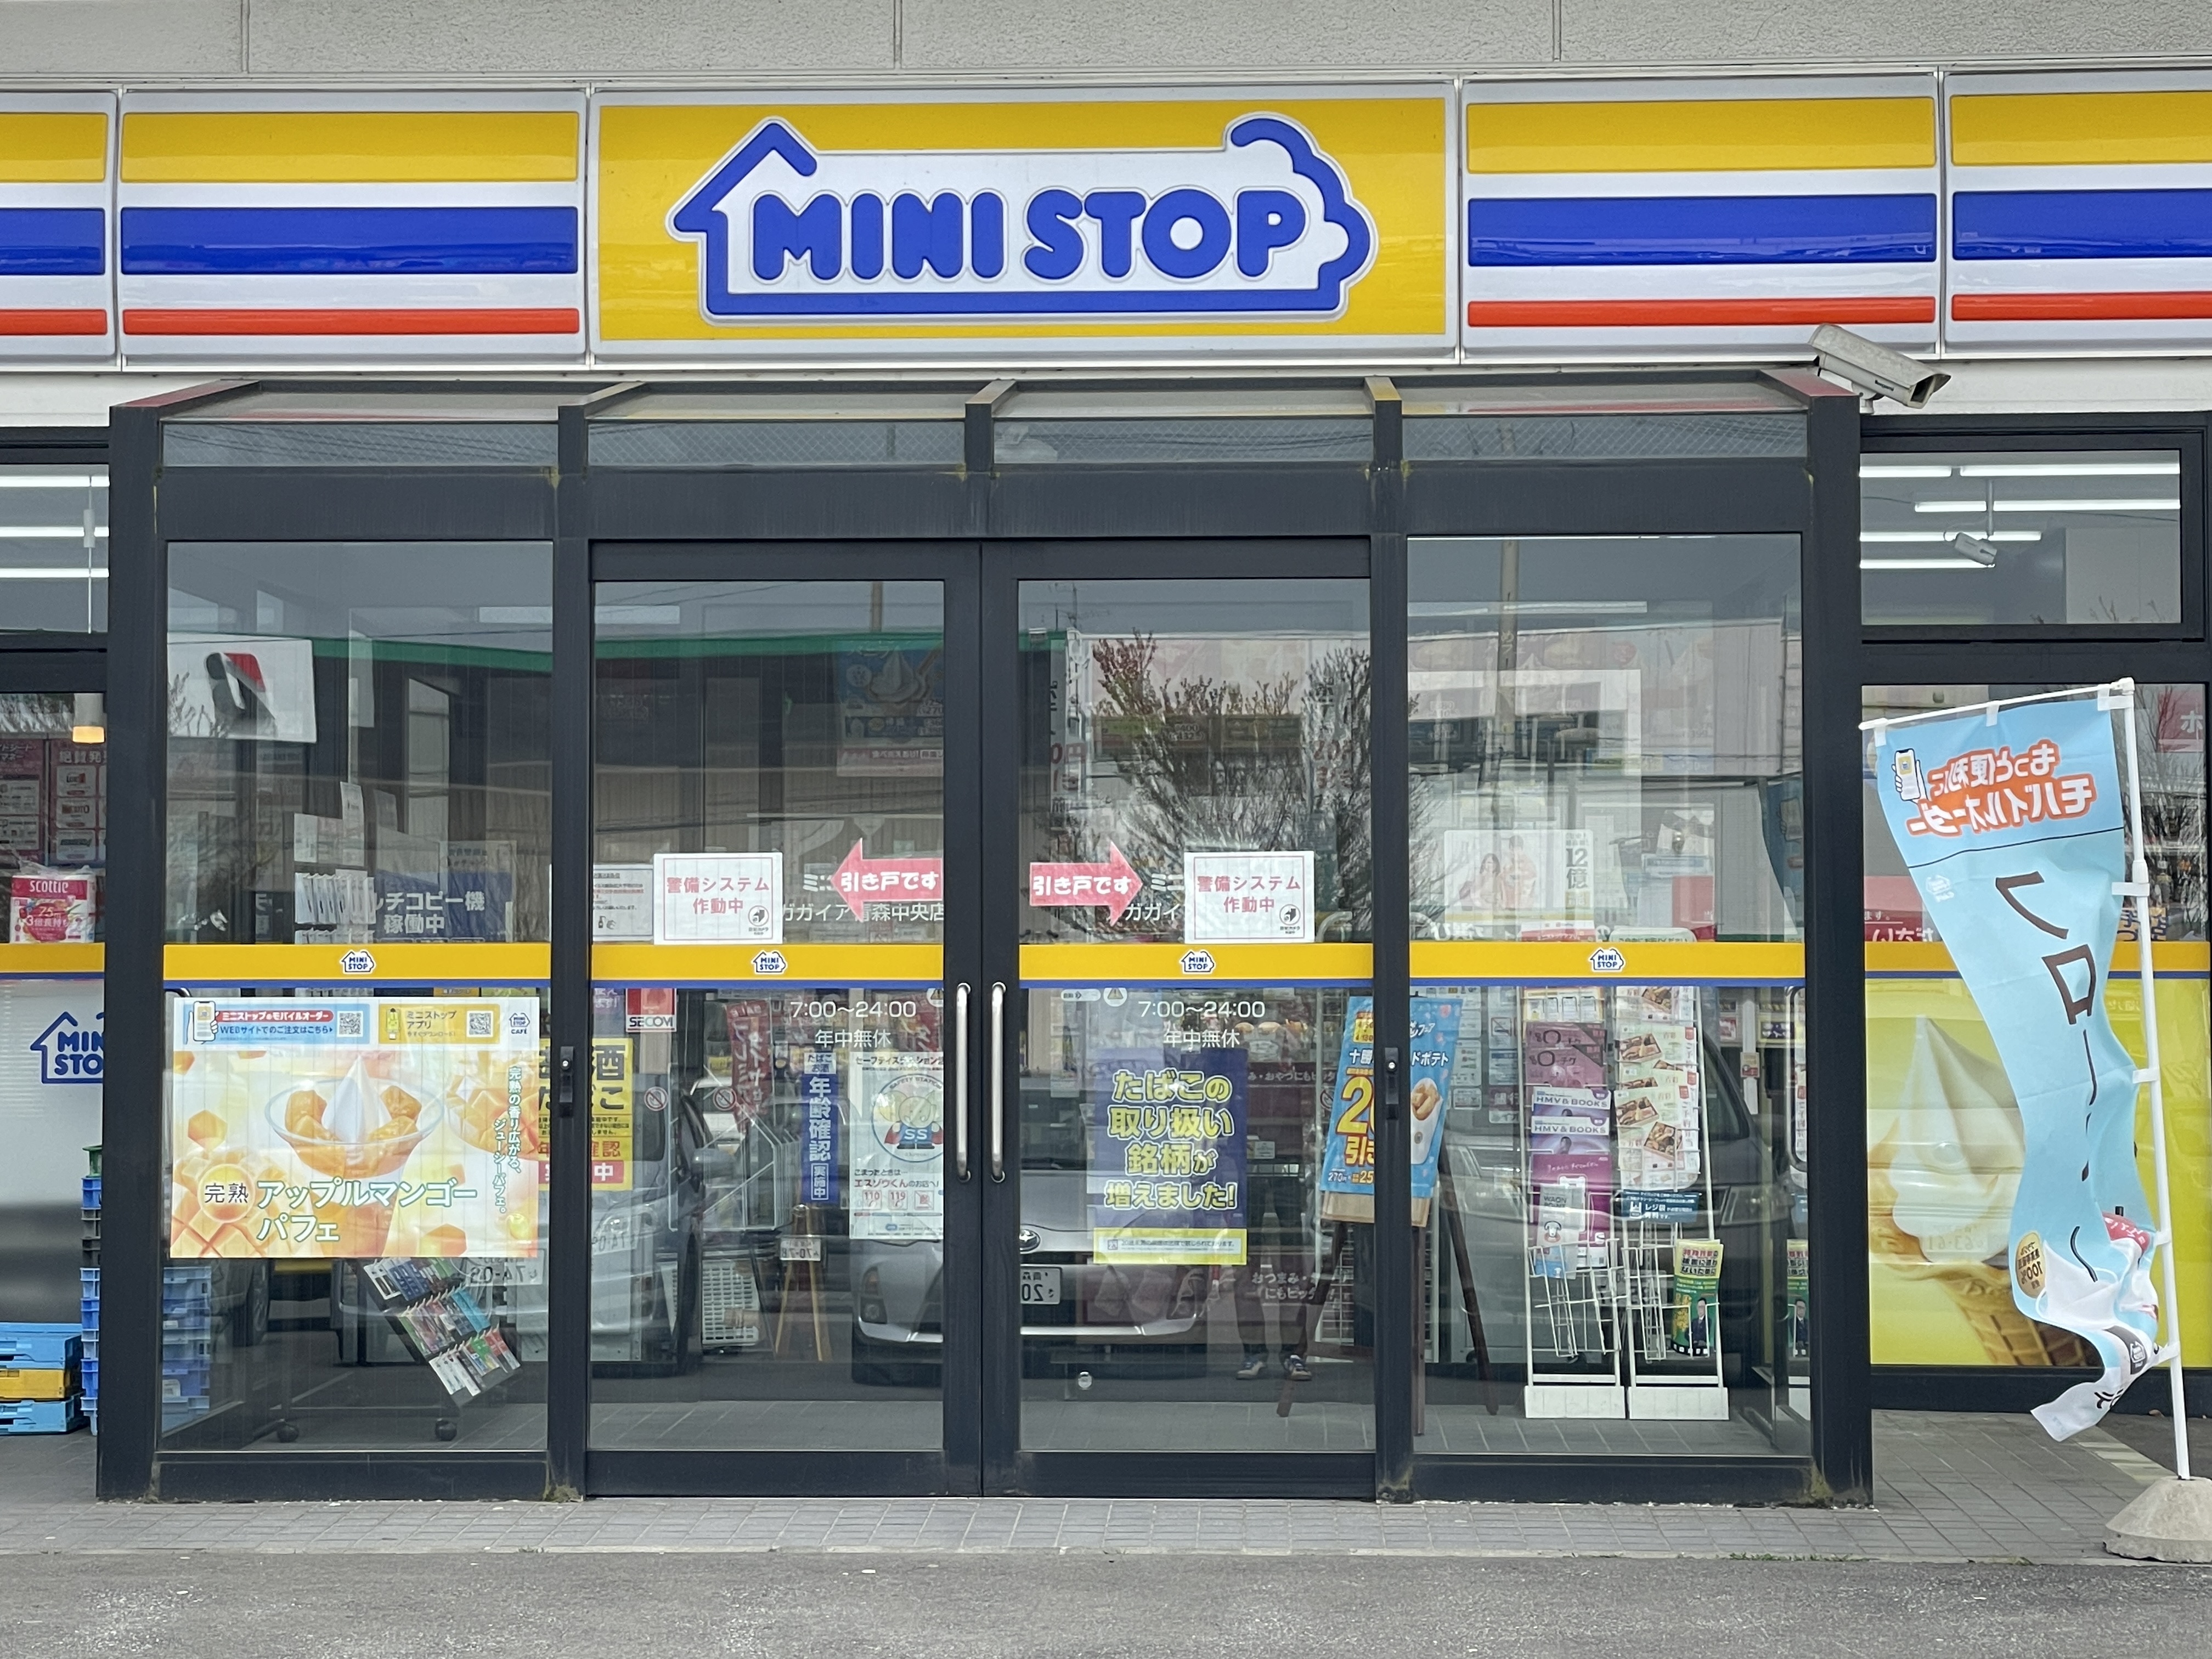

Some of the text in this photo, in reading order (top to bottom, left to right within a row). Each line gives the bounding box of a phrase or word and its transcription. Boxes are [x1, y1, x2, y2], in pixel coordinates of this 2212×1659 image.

[753, 188, 1307, 280] MINI STOP
[667, 877, 769, 894] 警備システム
[840, 871, 939, 892] 引き戸です
[1032, 875, 1132, 896] 引き戸です
[1197, 876, 1301, 893] 警備システム
[375, 890, 485, 912] チコピー機
[693, 898, 744, 915] 作動中
[1223, 896, 1274, 913] 作動中
[383, 913, 445, 934] 稼働中
[222, 1012, 329, 1022] ミニストップのモバイルオーダー
[407, 1010, 457, 1020] ミニストップ
[407, 1020, 431, 1030] アプリ
[629, 1016, 674, 1028] SECOM
[220, 1025, 329, 1035] WEBサイトでのご注文はこちら
[815, 1029, 891, 1048] 年中無休
[1163, 1029, 1240, 1049] 年中無休
[54, 1054, 104, 1075] STO
[1112, 1068, 1232, 1102] たばこの
[1336, 1075, 1374, 1135] 2
[507, 1066, 522, 1174] 完熟の香り広がる、
[809, 1076, 832, 1162] 年齢確認
[1107, 1104, 1234, 1141] 取り扱い
[904, 1129, 928, 1141] SS
[493, 1118, 506, 1214] ジューシーパフェ。
[1126, 1141, 1218, 1177] 銘柄が
[205, 1184, 249, 1204] 完熟
[256, 1176, 478, 1209] アップルマンゴー
[864, 1190, 880, 1200] 110
[890, 1190, 906, 1201] 119
[1104, 1180, 1238, 1210] 増えました!
[256, 1212, 340, 1243] パフェ
